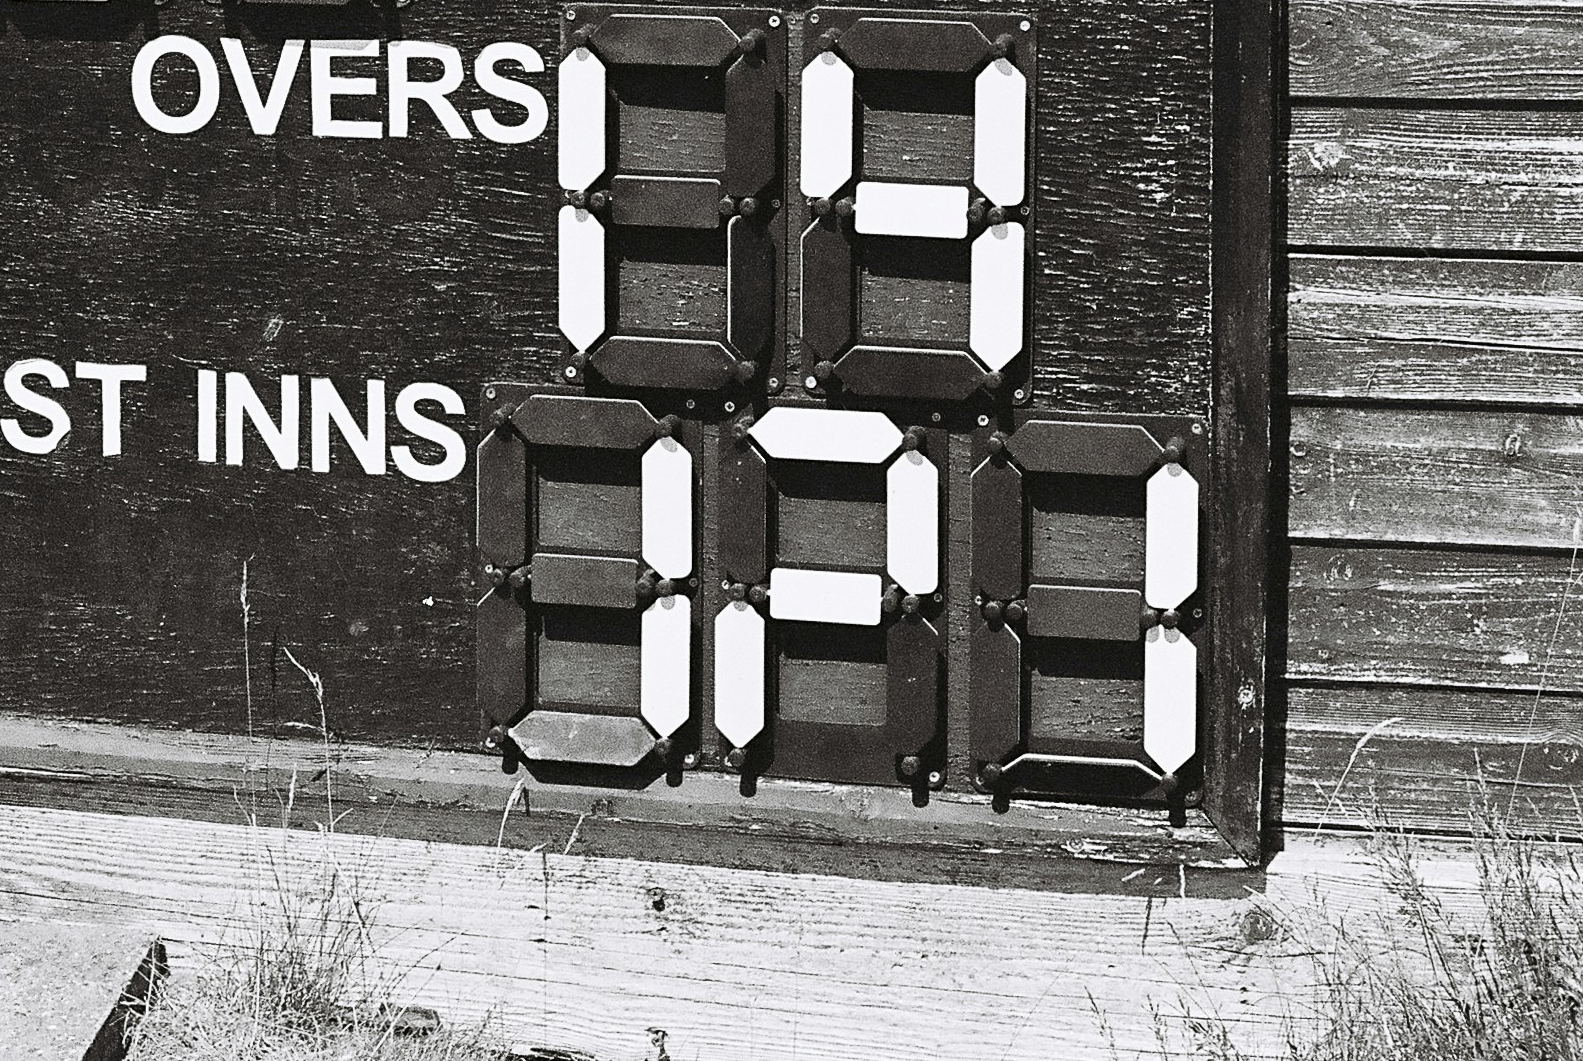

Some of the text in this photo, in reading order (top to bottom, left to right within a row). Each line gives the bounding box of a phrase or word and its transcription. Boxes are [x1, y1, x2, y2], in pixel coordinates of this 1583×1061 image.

[131, 34, 1027, 375] OVERS 14
[197, 369, 466, 483] INNS
